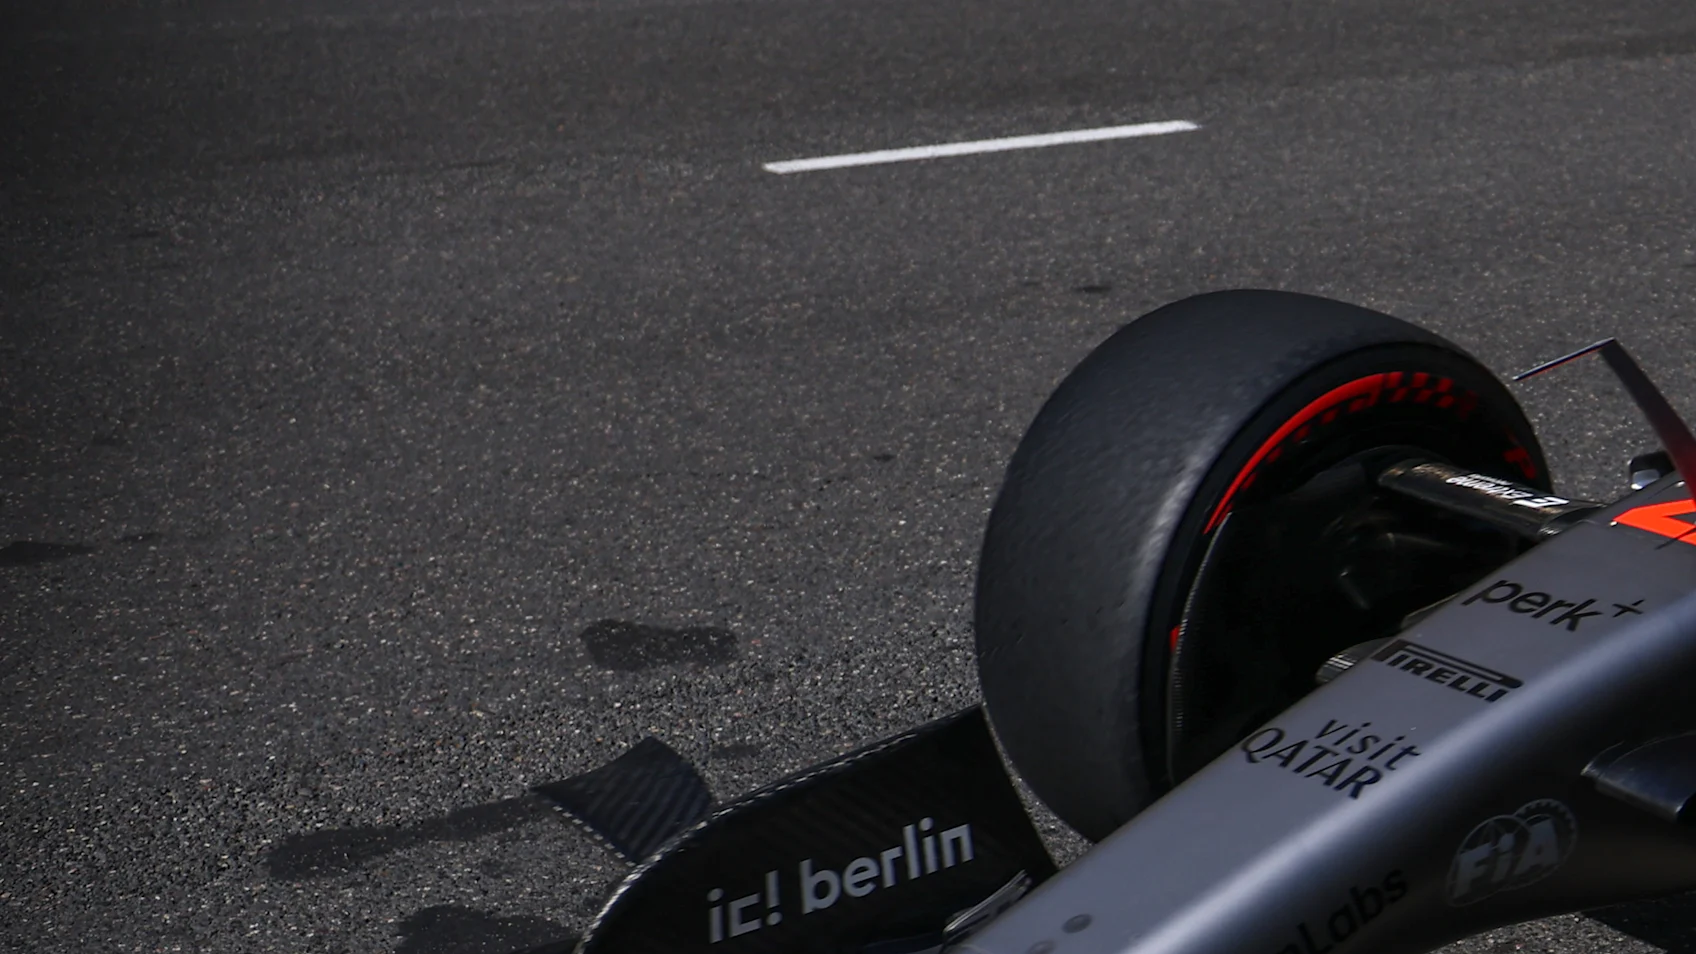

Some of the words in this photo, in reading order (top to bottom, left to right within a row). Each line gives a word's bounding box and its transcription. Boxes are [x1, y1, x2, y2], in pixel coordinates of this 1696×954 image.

[1371, 640, 1523, 703] PIRELLI
[1240, 726, 1384, 800] QATAR
[1314, 716, 1422, 770] visit
[800, 815, 976, 915] berlin
